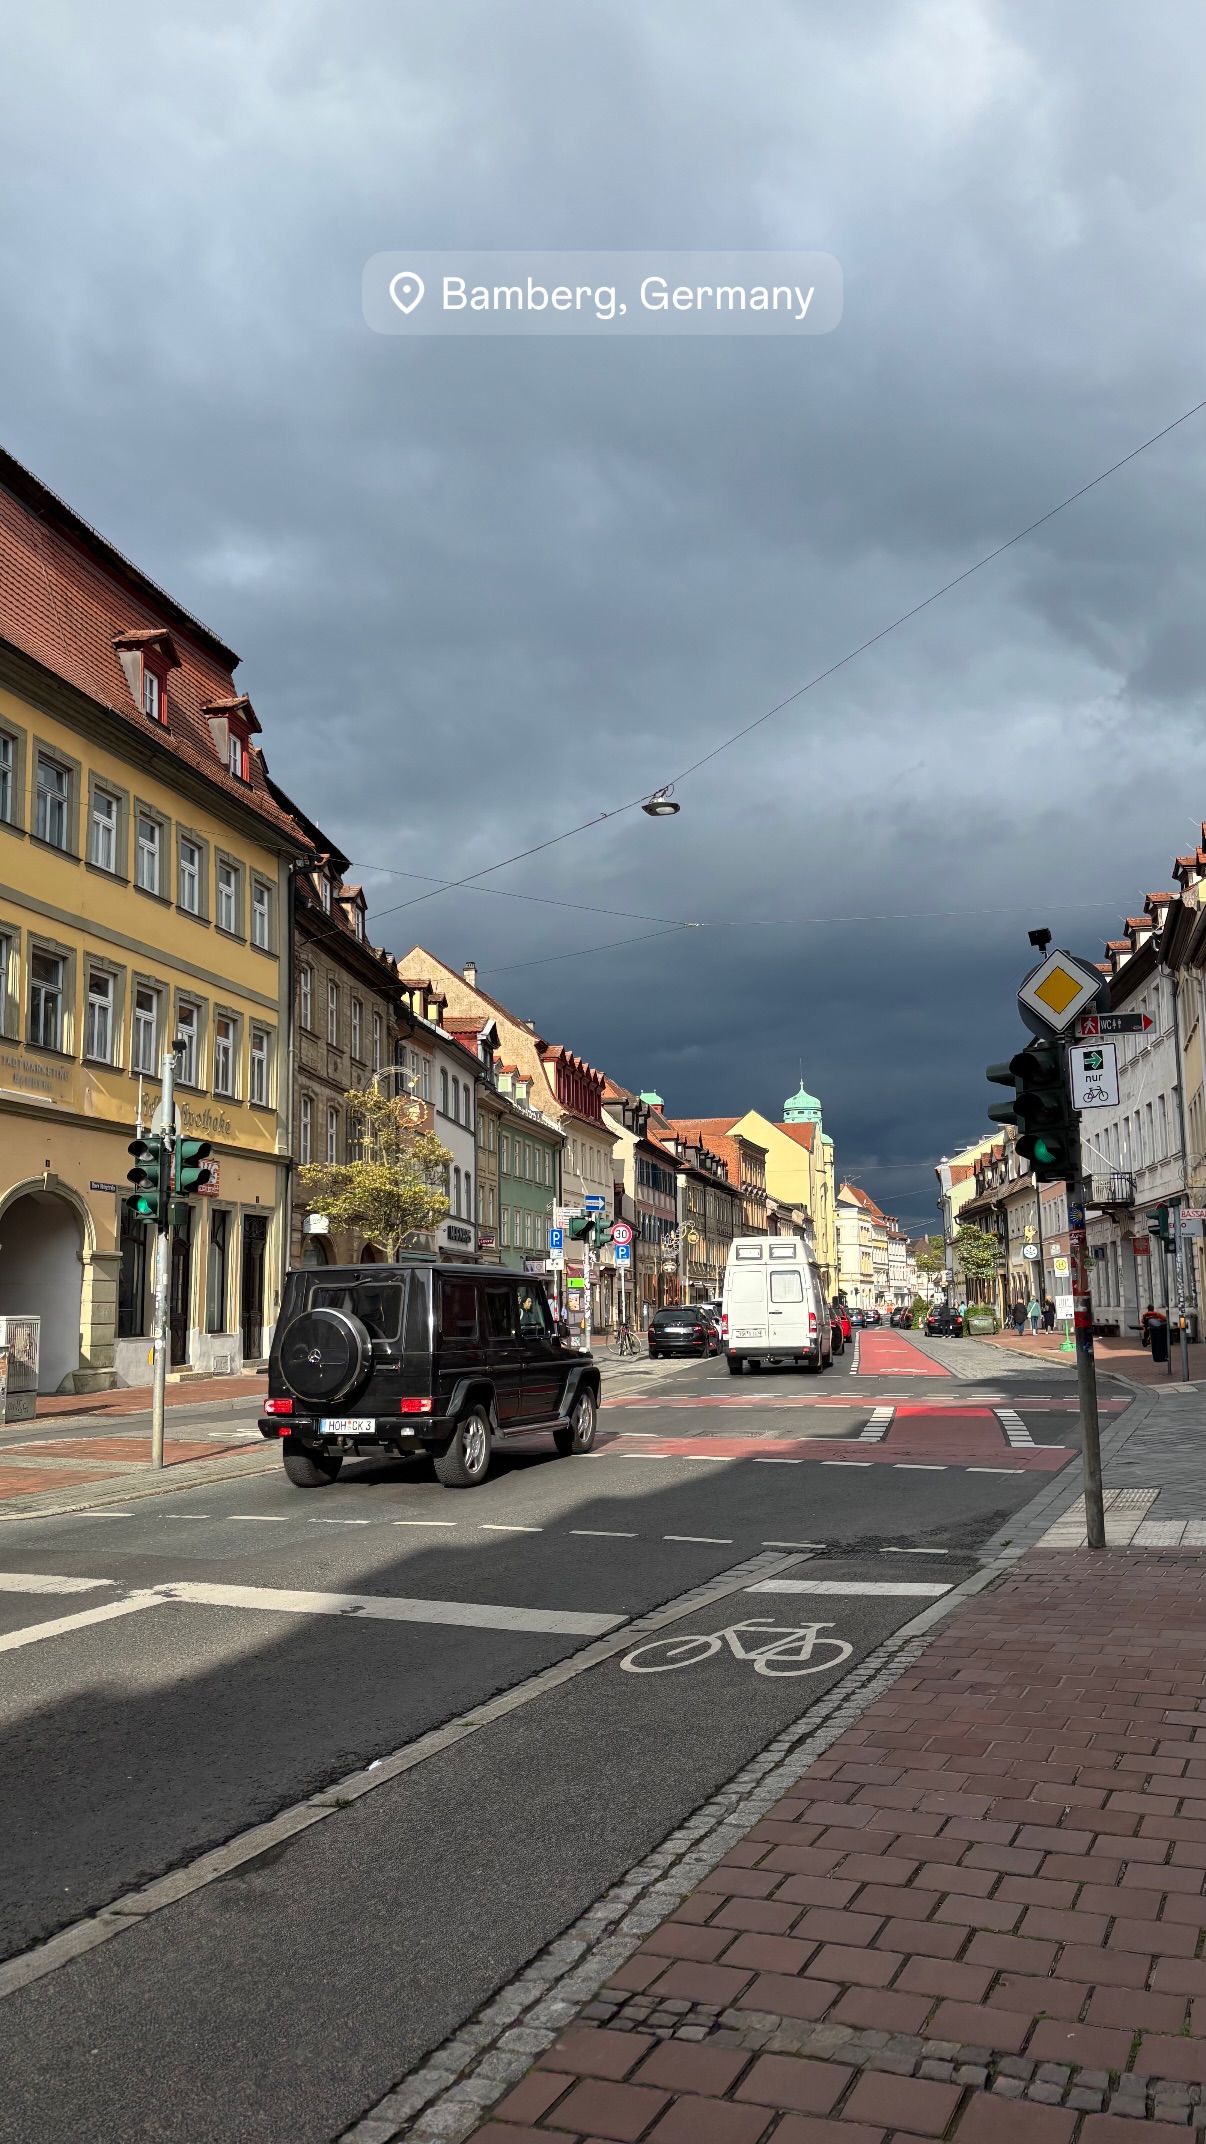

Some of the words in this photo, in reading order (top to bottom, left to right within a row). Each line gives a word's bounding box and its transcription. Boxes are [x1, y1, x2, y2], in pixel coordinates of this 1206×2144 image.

[1100, 1019, 1112, 1030] WC
[1085, 1073, 1103, 1083] nur
[553, 1231, 560, 1246] P
[615, 1229, 628, 1239] 30
[618, 1246, 627, 1259] P
[328, 1421, 347, 1431] HOH
[352, 1421, 363, 1431] CK
[365, 1421, 372, 1431] 3
